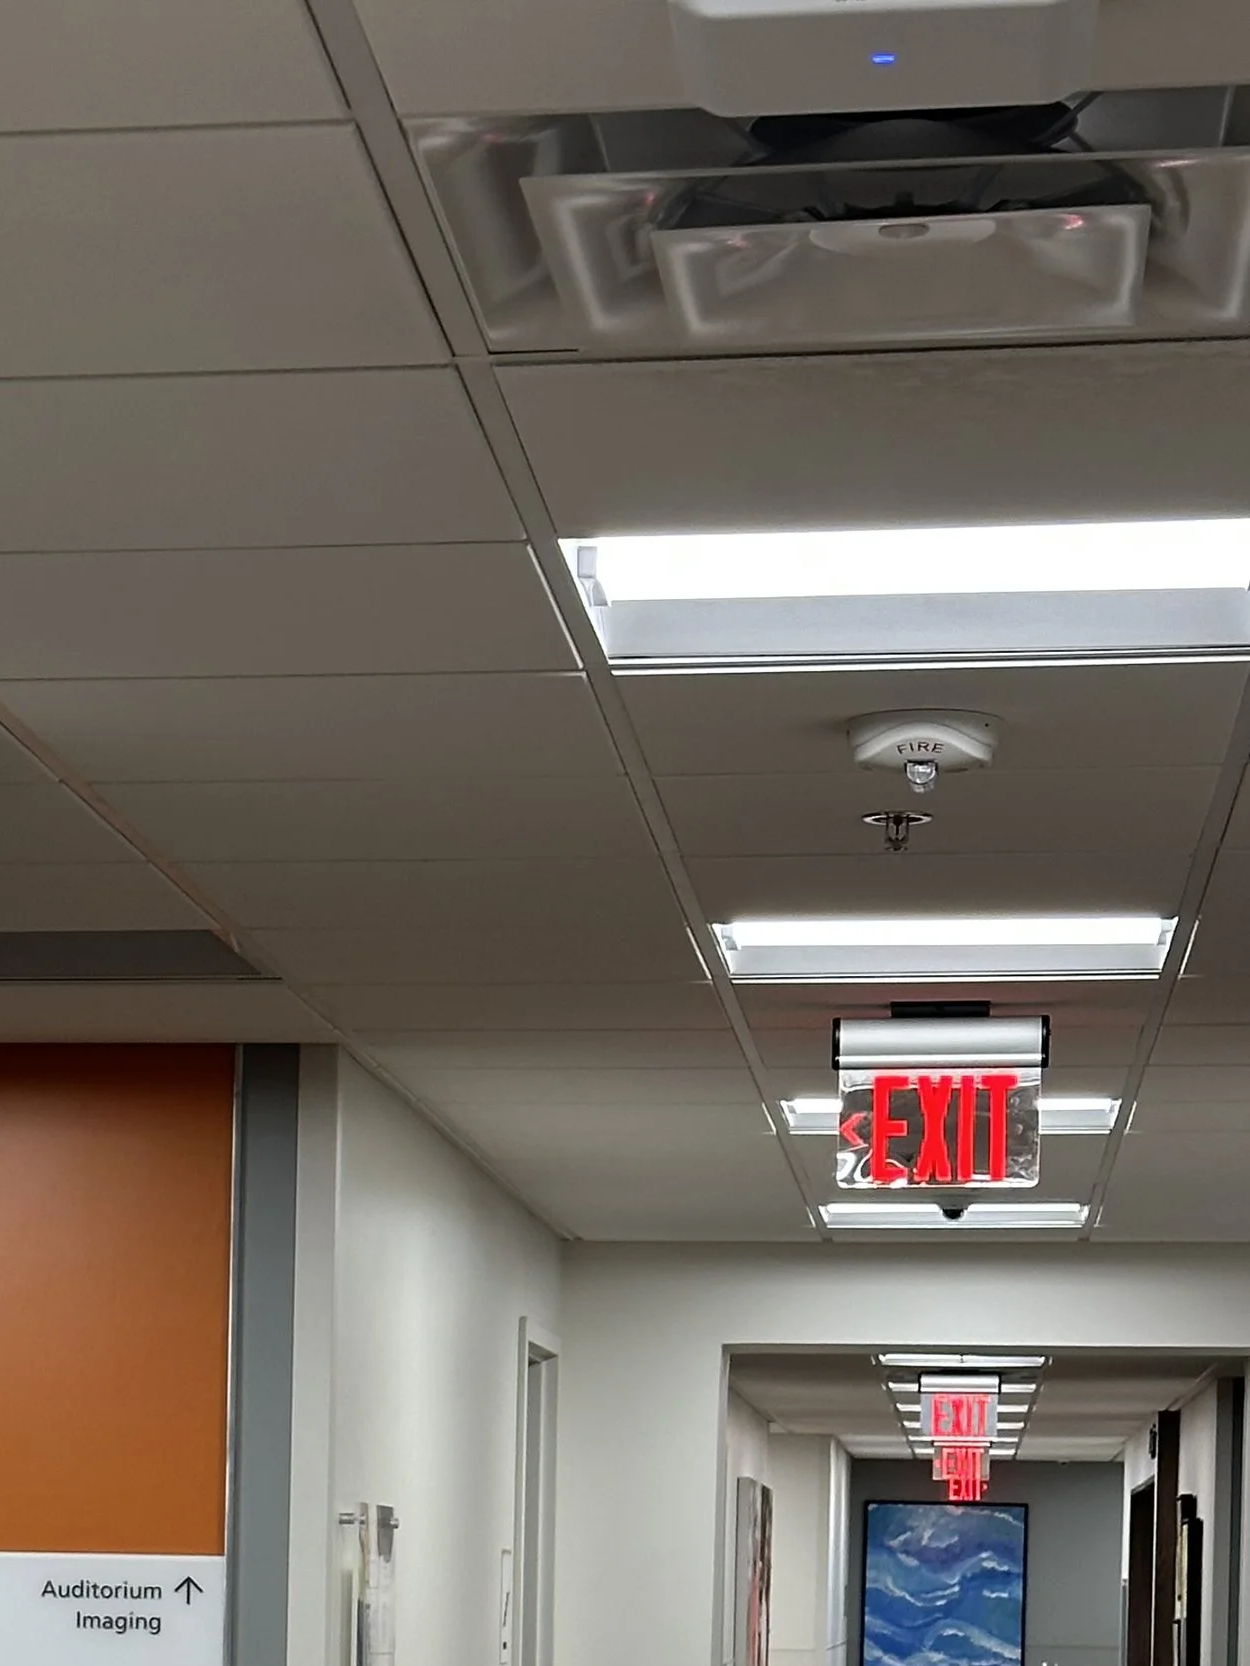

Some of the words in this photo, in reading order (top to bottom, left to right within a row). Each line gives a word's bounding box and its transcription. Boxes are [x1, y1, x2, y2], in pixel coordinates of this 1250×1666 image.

[897, 741, 945, 755] FIRE
[871, 1074, 1019, 1183] EXIT
[931, 1392, 991, 1438] EXIT
[942, 1447, 985, 1480] EXIT
[41, 1579, 163, 1600] Auditorium
[75, 1610, 162, 1636] Imaging
